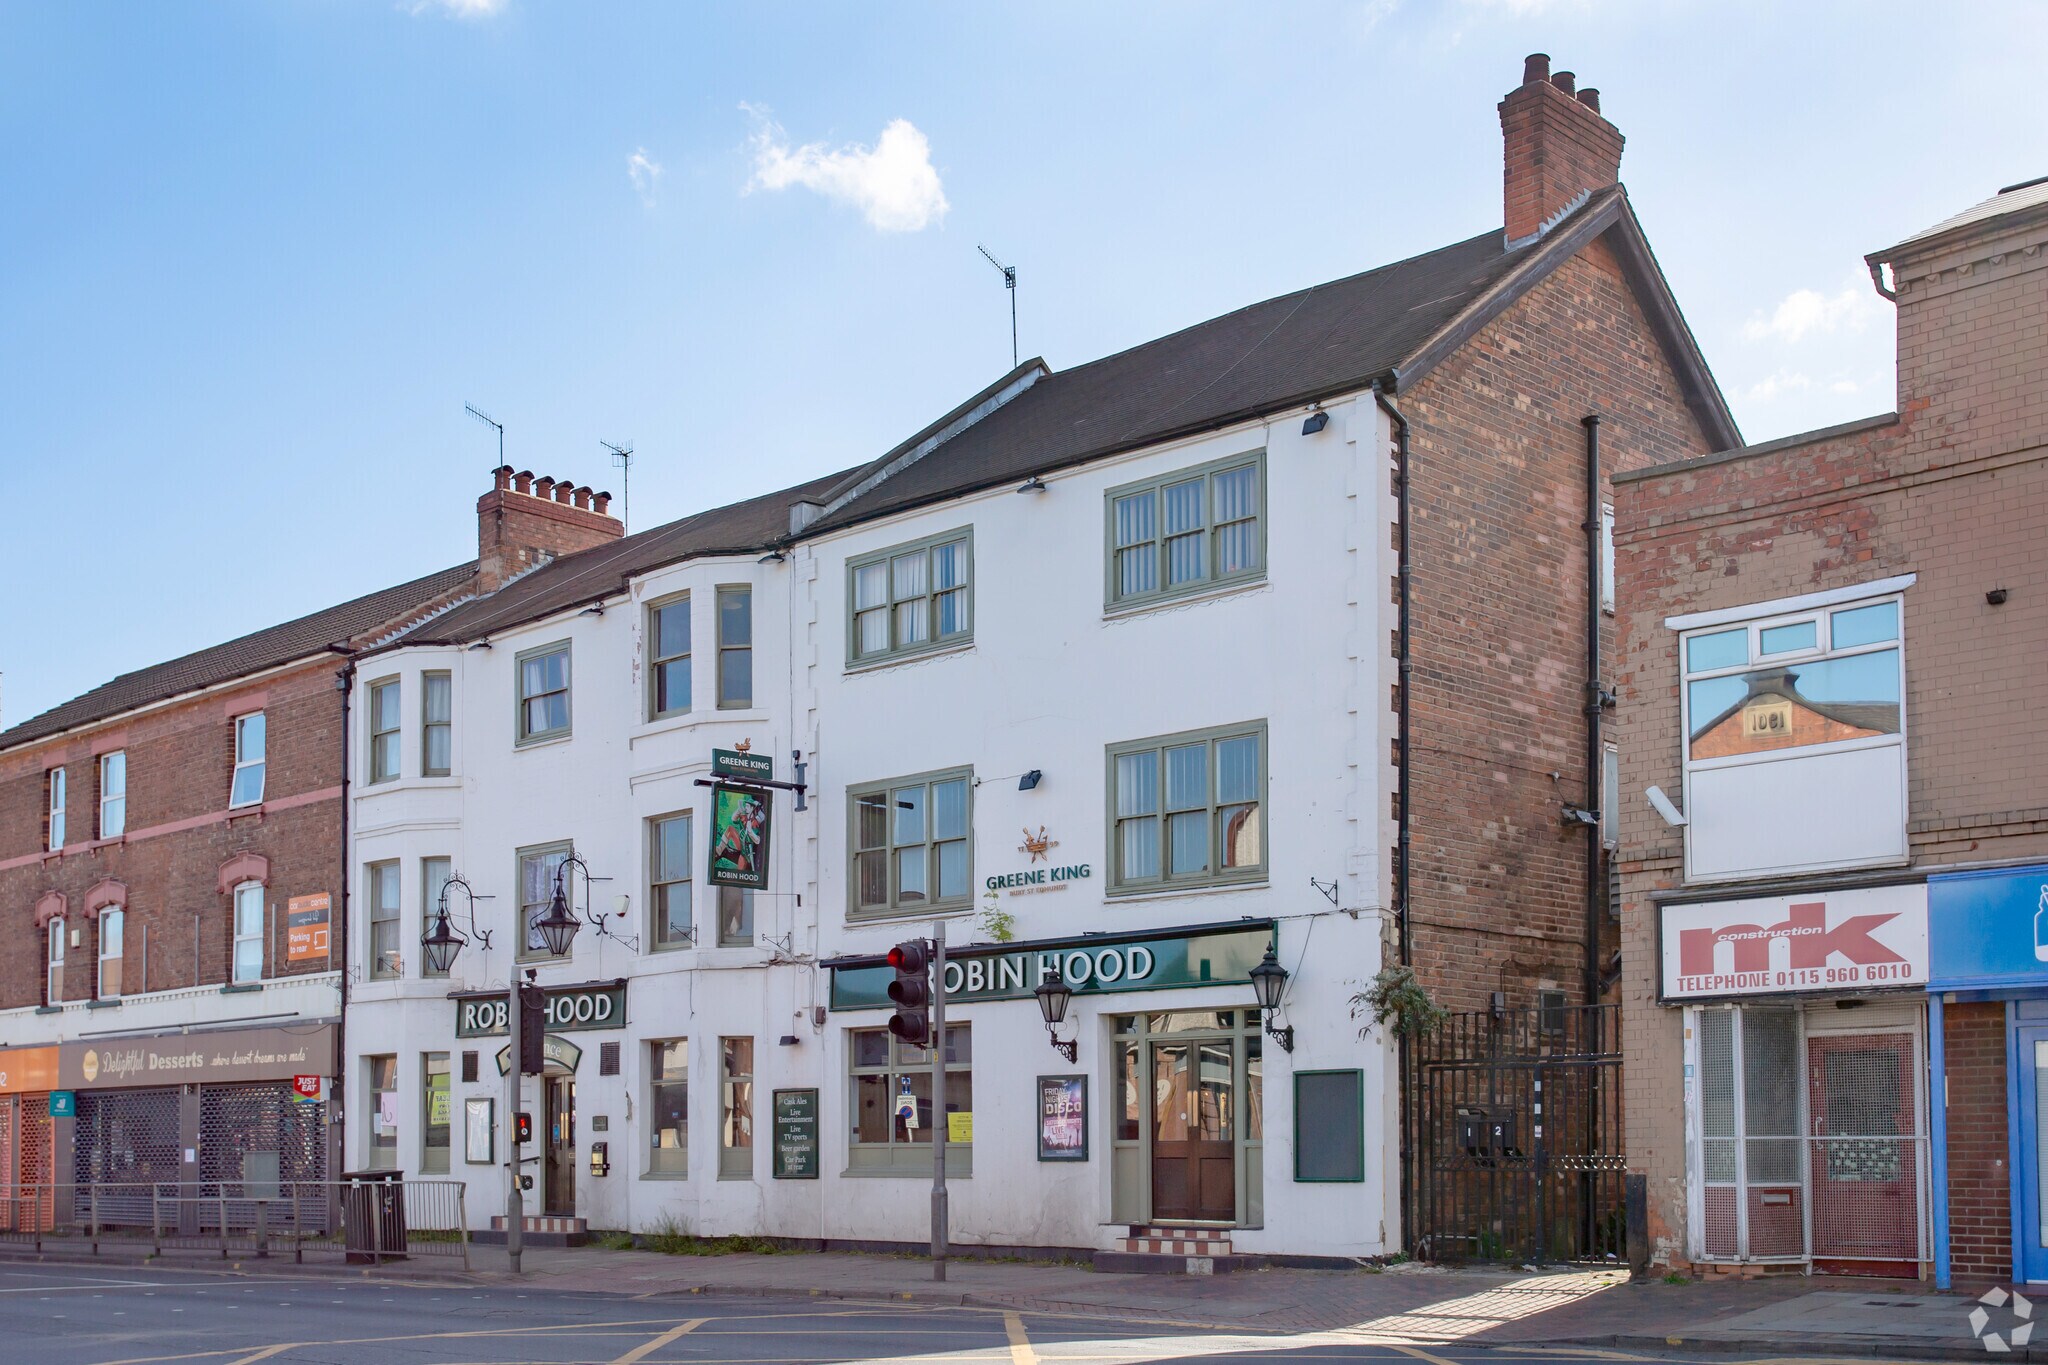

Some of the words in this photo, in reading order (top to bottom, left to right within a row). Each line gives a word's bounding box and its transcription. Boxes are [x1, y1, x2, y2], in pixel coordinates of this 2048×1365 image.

[720, 756, 749, 768] GREENE
[750, 761, 769, 770] KING
[718, 871, 738, 880] ROBIN
[739, 873, 759, 881] HOOD
[986, 870, 1045, 889] GREENE
[1051, 864, 1090, 882] KING
[290, 933, 310, 942] Parking
[1717, 926, 1822, 942] construction
[297, 945, 307, 953] rear
[1038, 946, 1152, 986] HOOD
[1677, 972, 1770, 992] TELEPHONE
[1777, 969, 1820, 986] 0115
[1827, 967, 1859, 983] 960
[1866, 963, 1912, 981] 6010
[103, 1049, 145, 1079] Delightful
[149, 1051, 204, 1070] Desserts
[298, 1077, 317, 1085] JUST
[1045, 1088, 1066, 1096] FRIDAY
[1046, 1101, 1082, 1114] DISCO
[1495, 1126, 1501, 1136] 2
[792, 1134, 807, 1142] sports
[793, 1145, 810, 1153] garden
